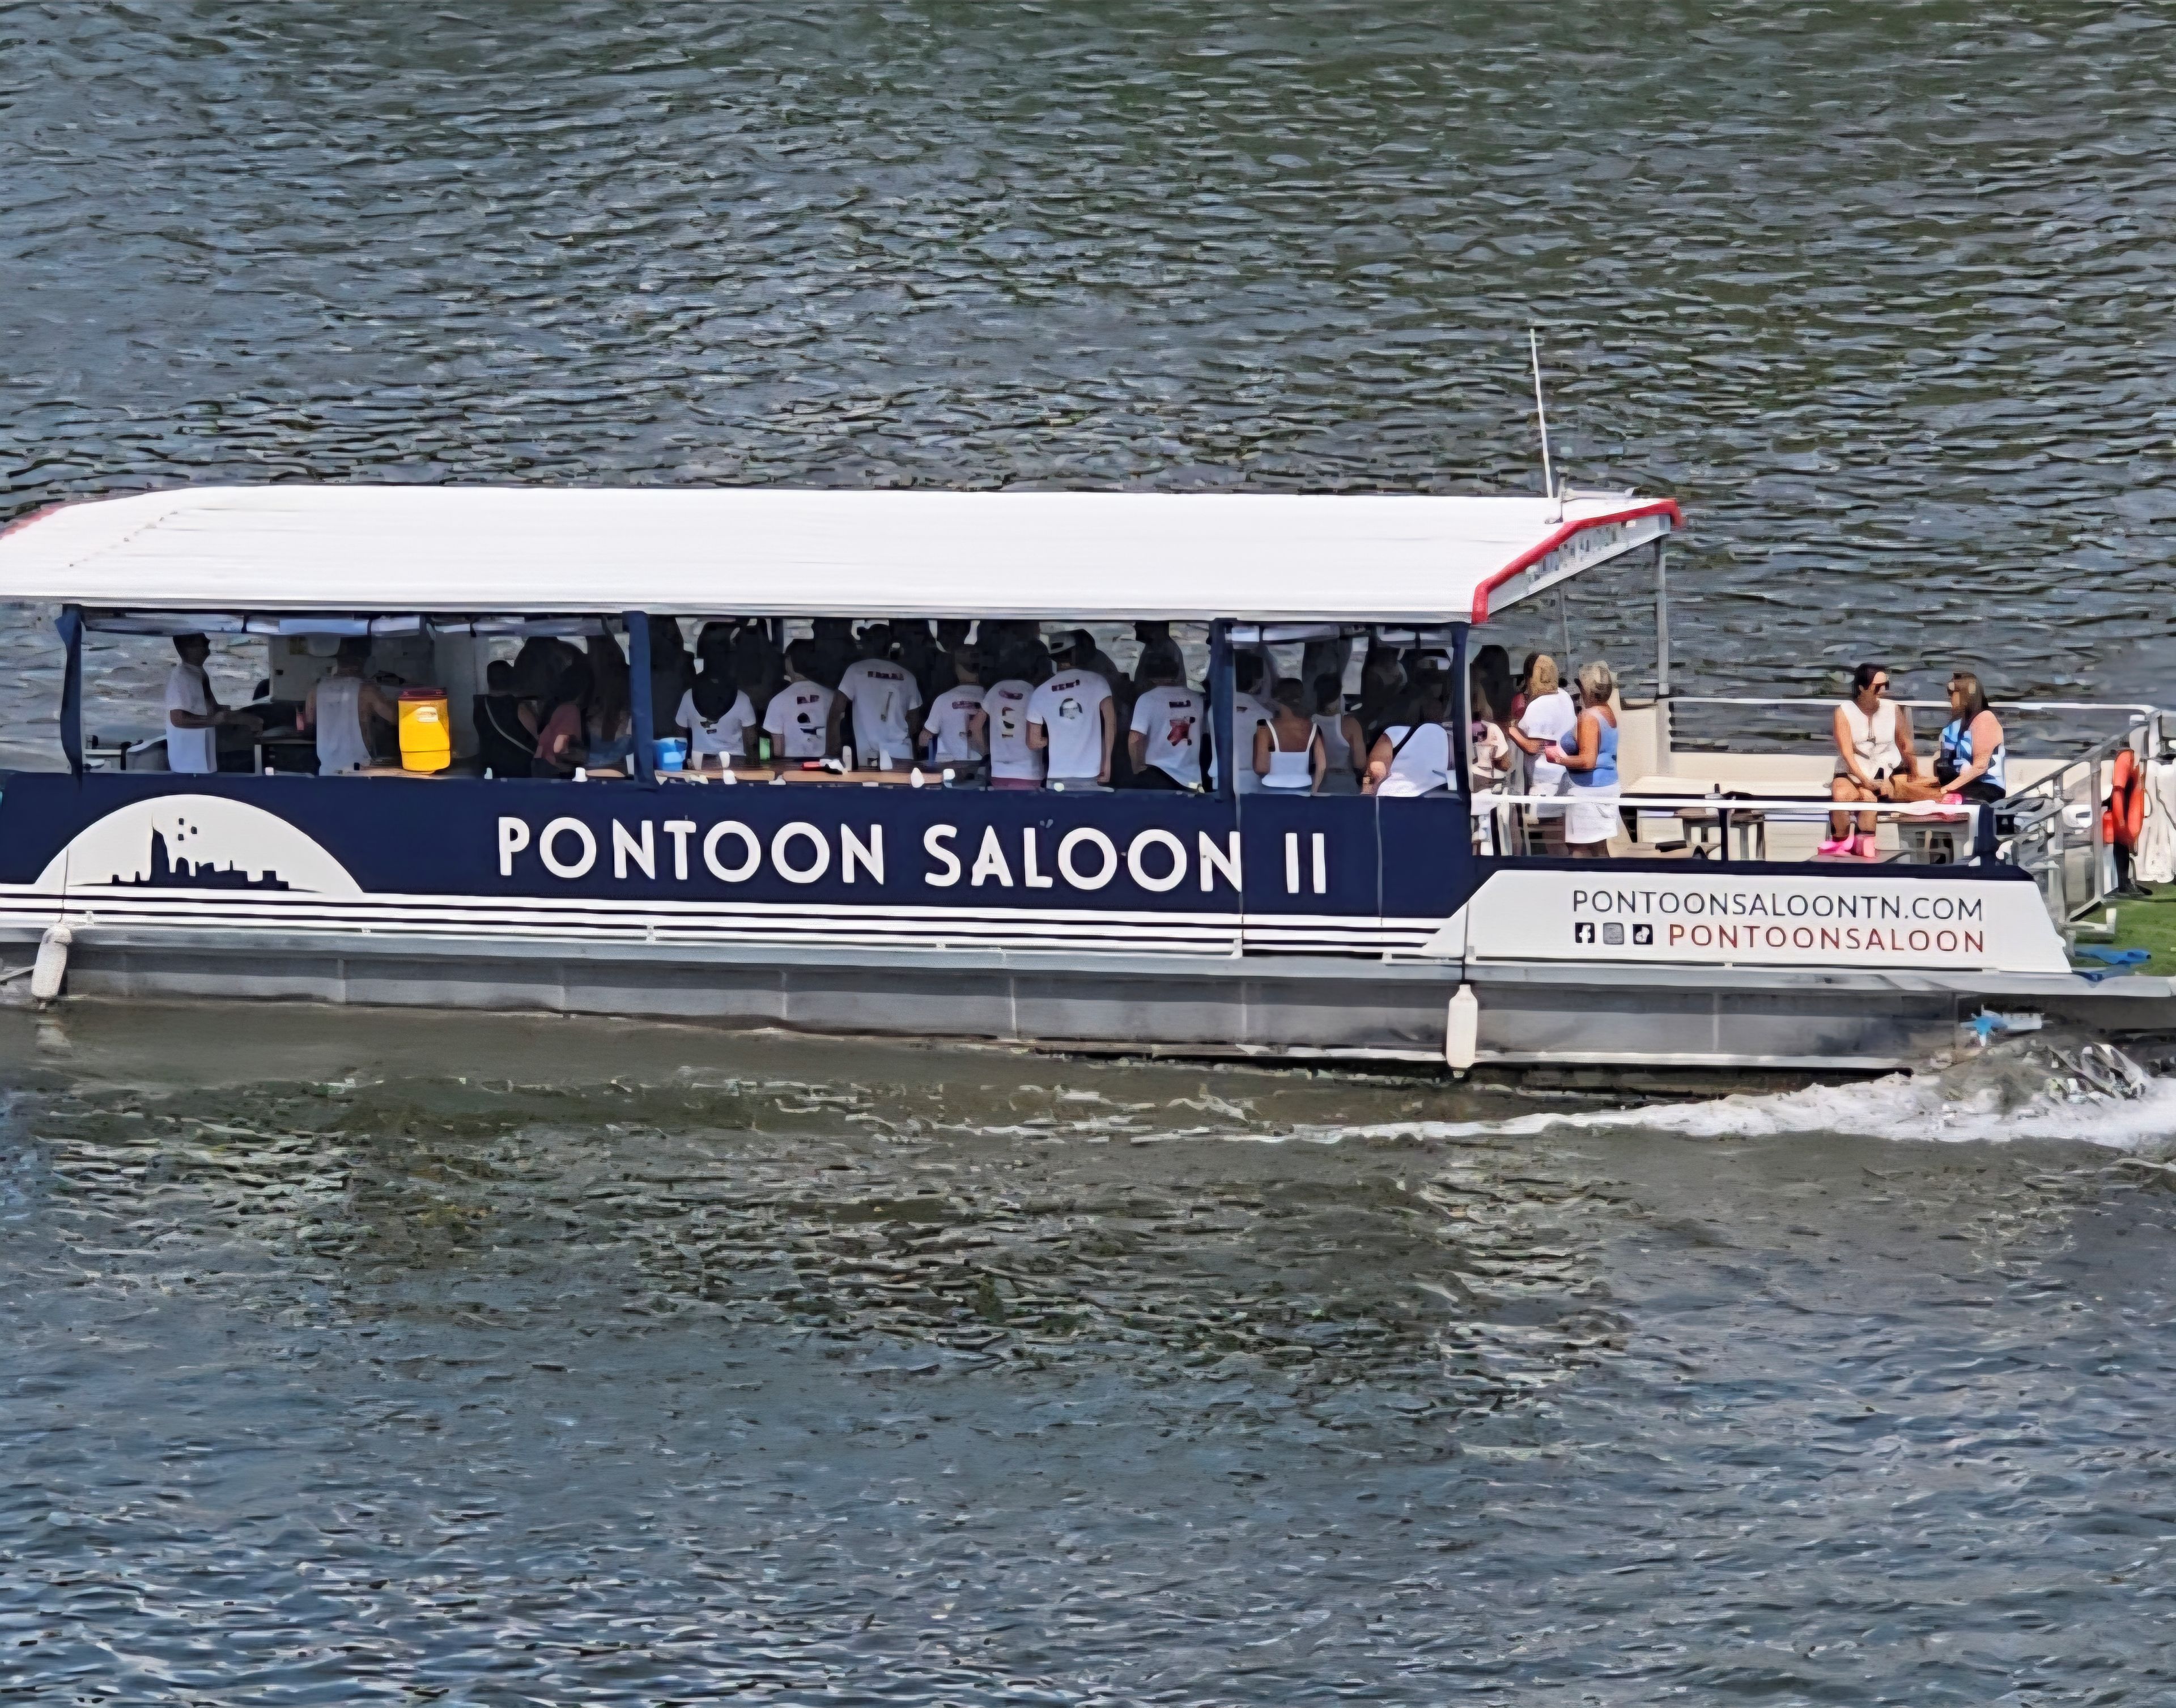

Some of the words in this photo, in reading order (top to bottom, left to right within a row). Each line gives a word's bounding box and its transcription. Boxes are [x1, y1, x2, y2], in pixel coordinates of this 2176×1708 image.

[498, 816, 884, 885] PONTOON
[923, 824, 1242, 893] SALOON
[1285, 832, 1327, 894] II
[1573, 889, 1983, 922] PONTOONSALOONTN.COM
[1669, 923, 1984, 953] PONTOONSALOON
